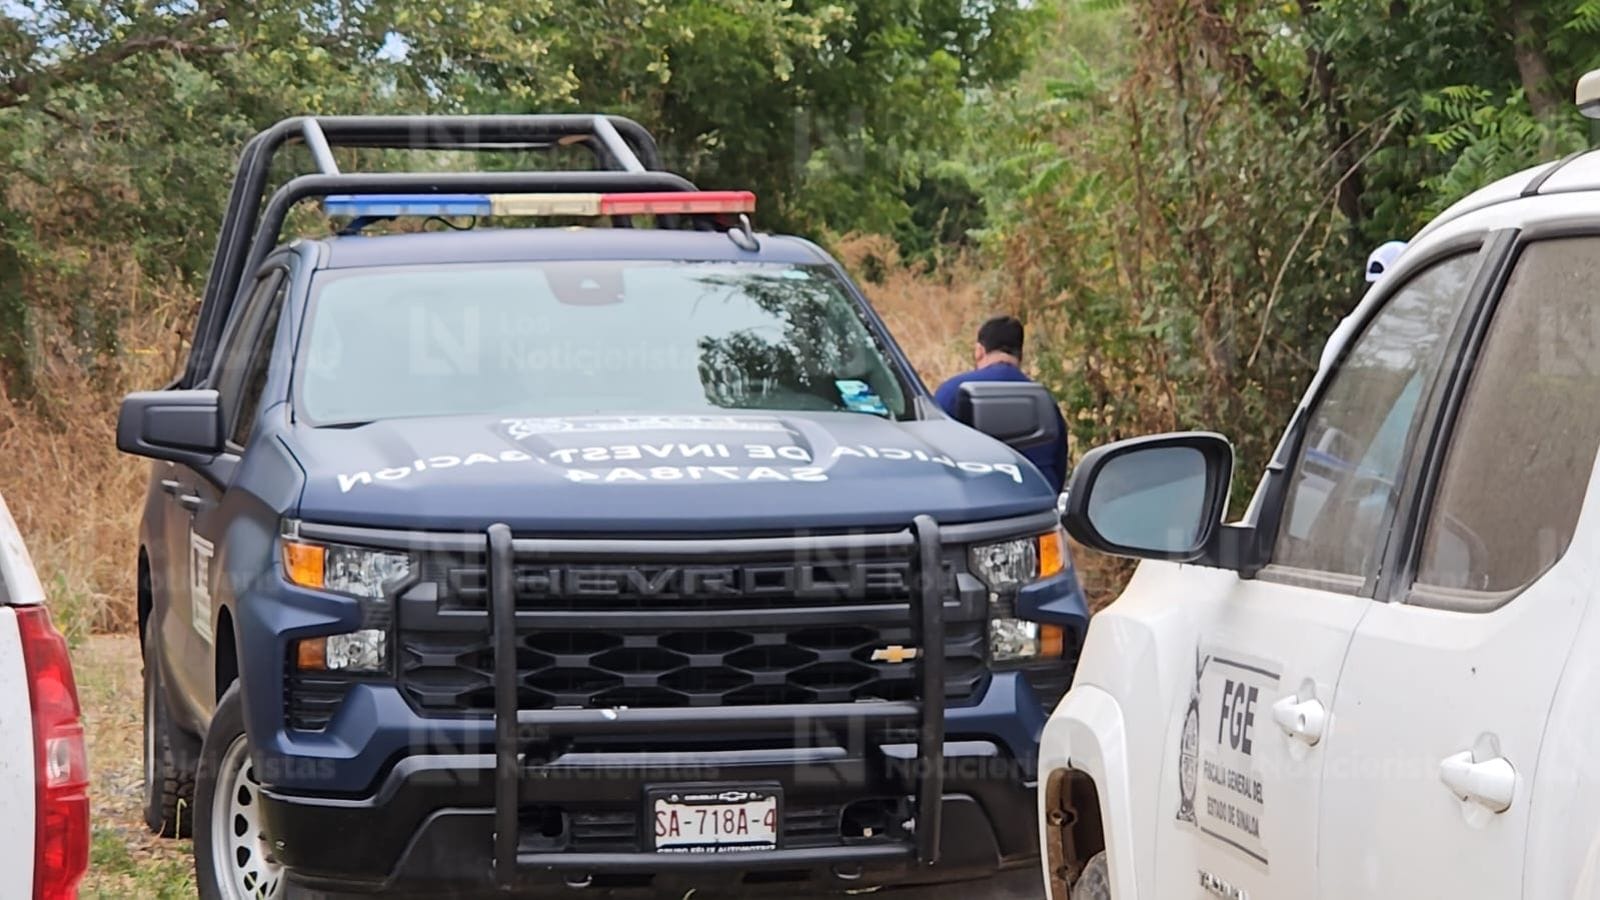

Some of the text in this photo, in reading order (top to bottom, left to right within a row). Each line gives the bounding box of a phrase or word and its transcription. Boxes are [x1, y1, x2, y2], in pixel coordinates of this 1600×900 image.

[447, 565, 952, 598] CHEVROLE
[1218, 679, 1259, 756] FGE
[1227, 768, 1252, 799] GENERAL
[1252, 780, 1264, 805] DEL
[656, 808, 777, 837] SA-718A-4
[1206, 796, 1260, 839] ESTADO DE SINALOA
